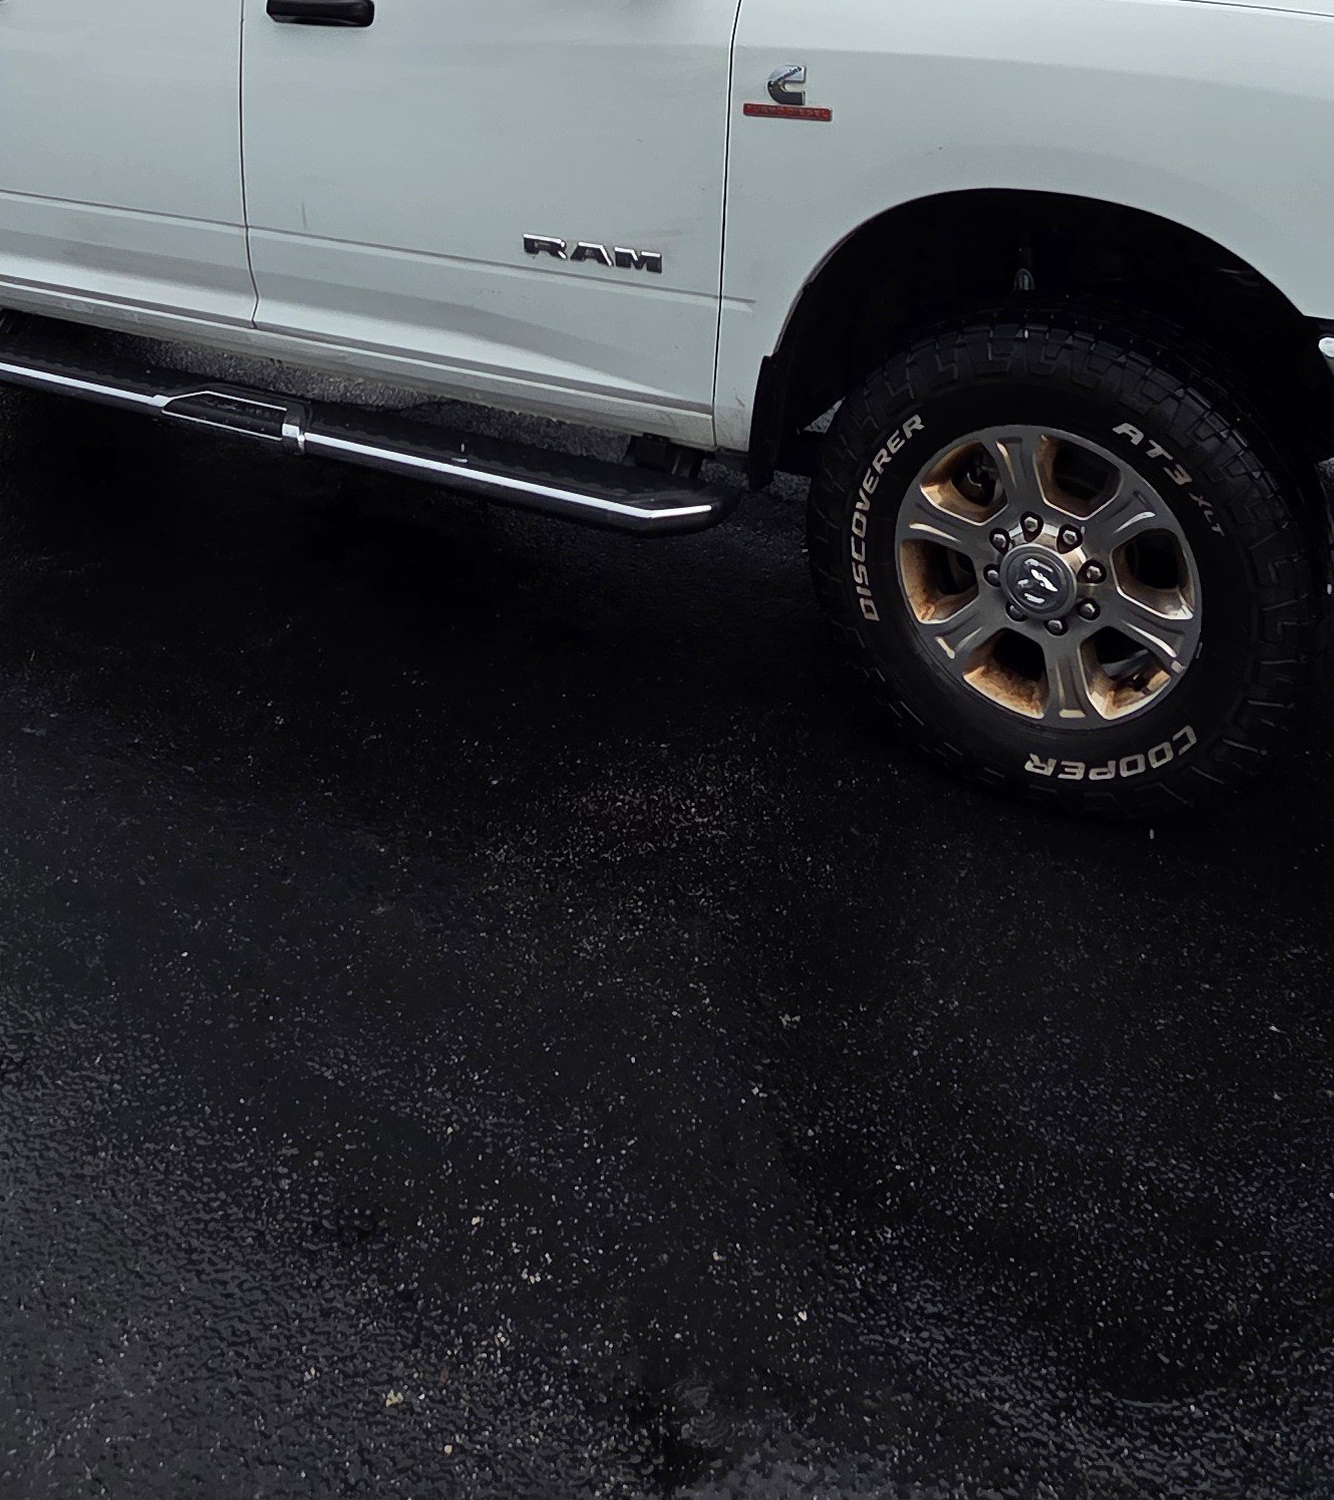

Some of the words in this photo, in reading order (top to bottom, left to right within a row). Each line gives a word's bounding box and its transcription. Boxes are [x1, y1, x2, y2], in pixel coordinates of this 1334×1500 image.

[523, 233, 663, 274] RAM
[851, 413, 925, 622] DISCOVERER
[1112, 422, 1193, 485] AT3
[1188, 492, 1225, 537] XLT
[1024, 724, 1198, 781] COOPER
